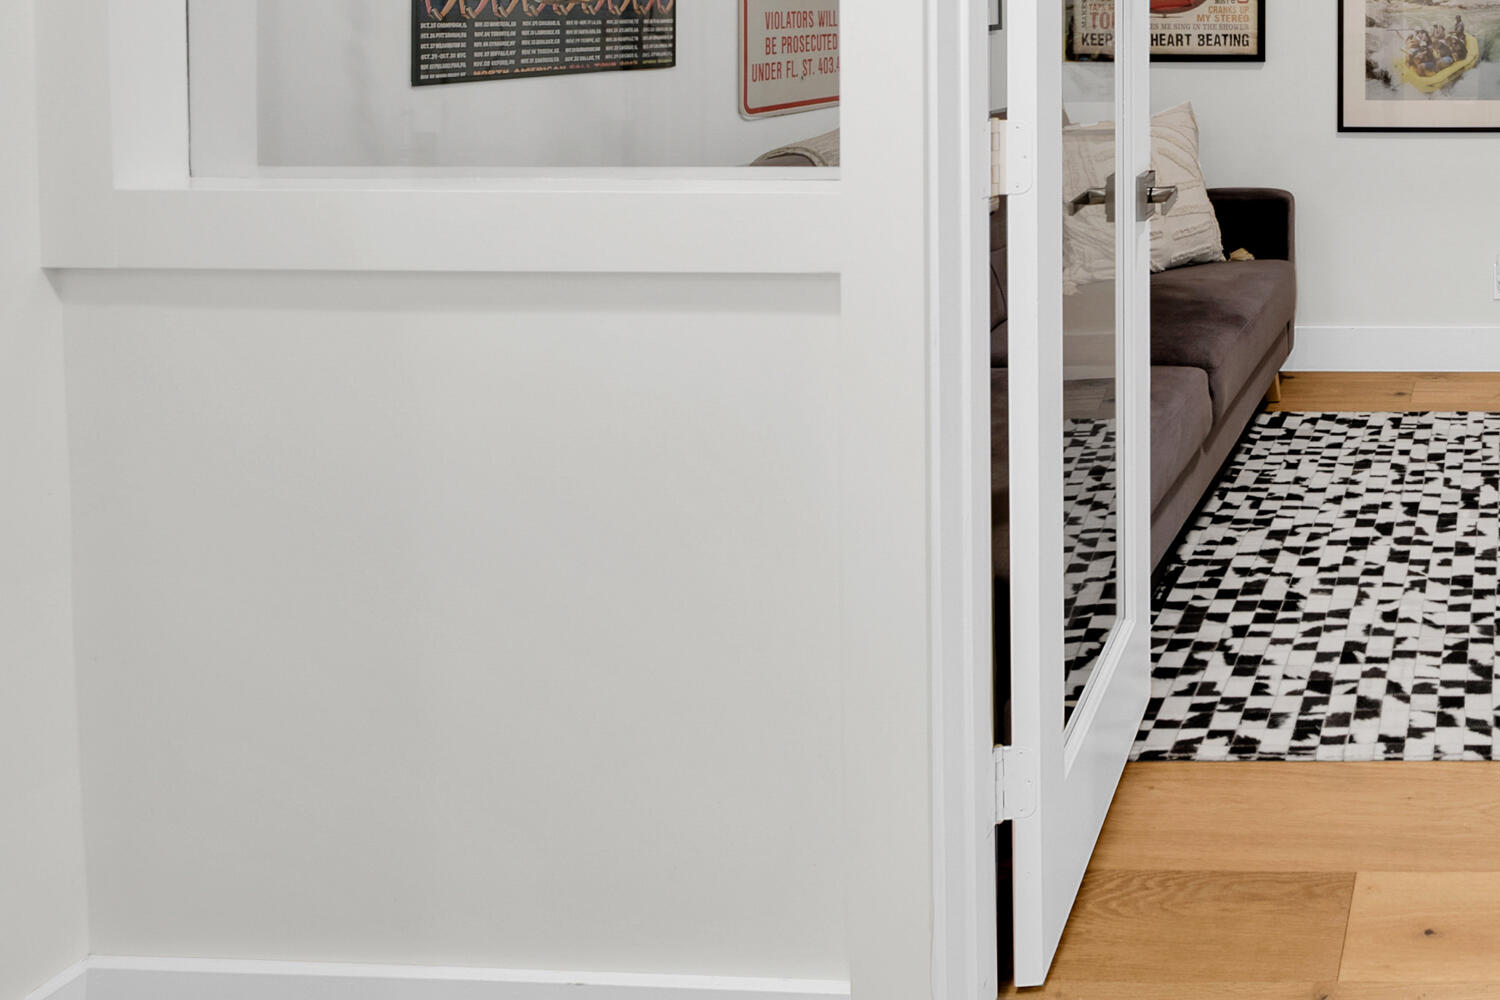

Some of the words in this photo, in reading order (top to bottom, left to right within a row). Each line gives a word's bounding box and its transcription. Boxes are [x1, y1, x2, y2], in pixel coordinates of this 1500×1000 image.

[764, 10, 814, 31] VIOLATORS
[818, 10, 838, 28] WILL
[1197, 14, 1210, 22] MY
[1214, 14, 1249, 22] STEREO
[764, 36, 777, 56] BE
[781, 33, 838, 55] PROSECUTED
[1150, 33, 1192, 47] HEART
[1197, 33, 1250, 47] BEATING
[751, 62, 782, 83] UNDER
[802, 58, 815, 78] ST.
